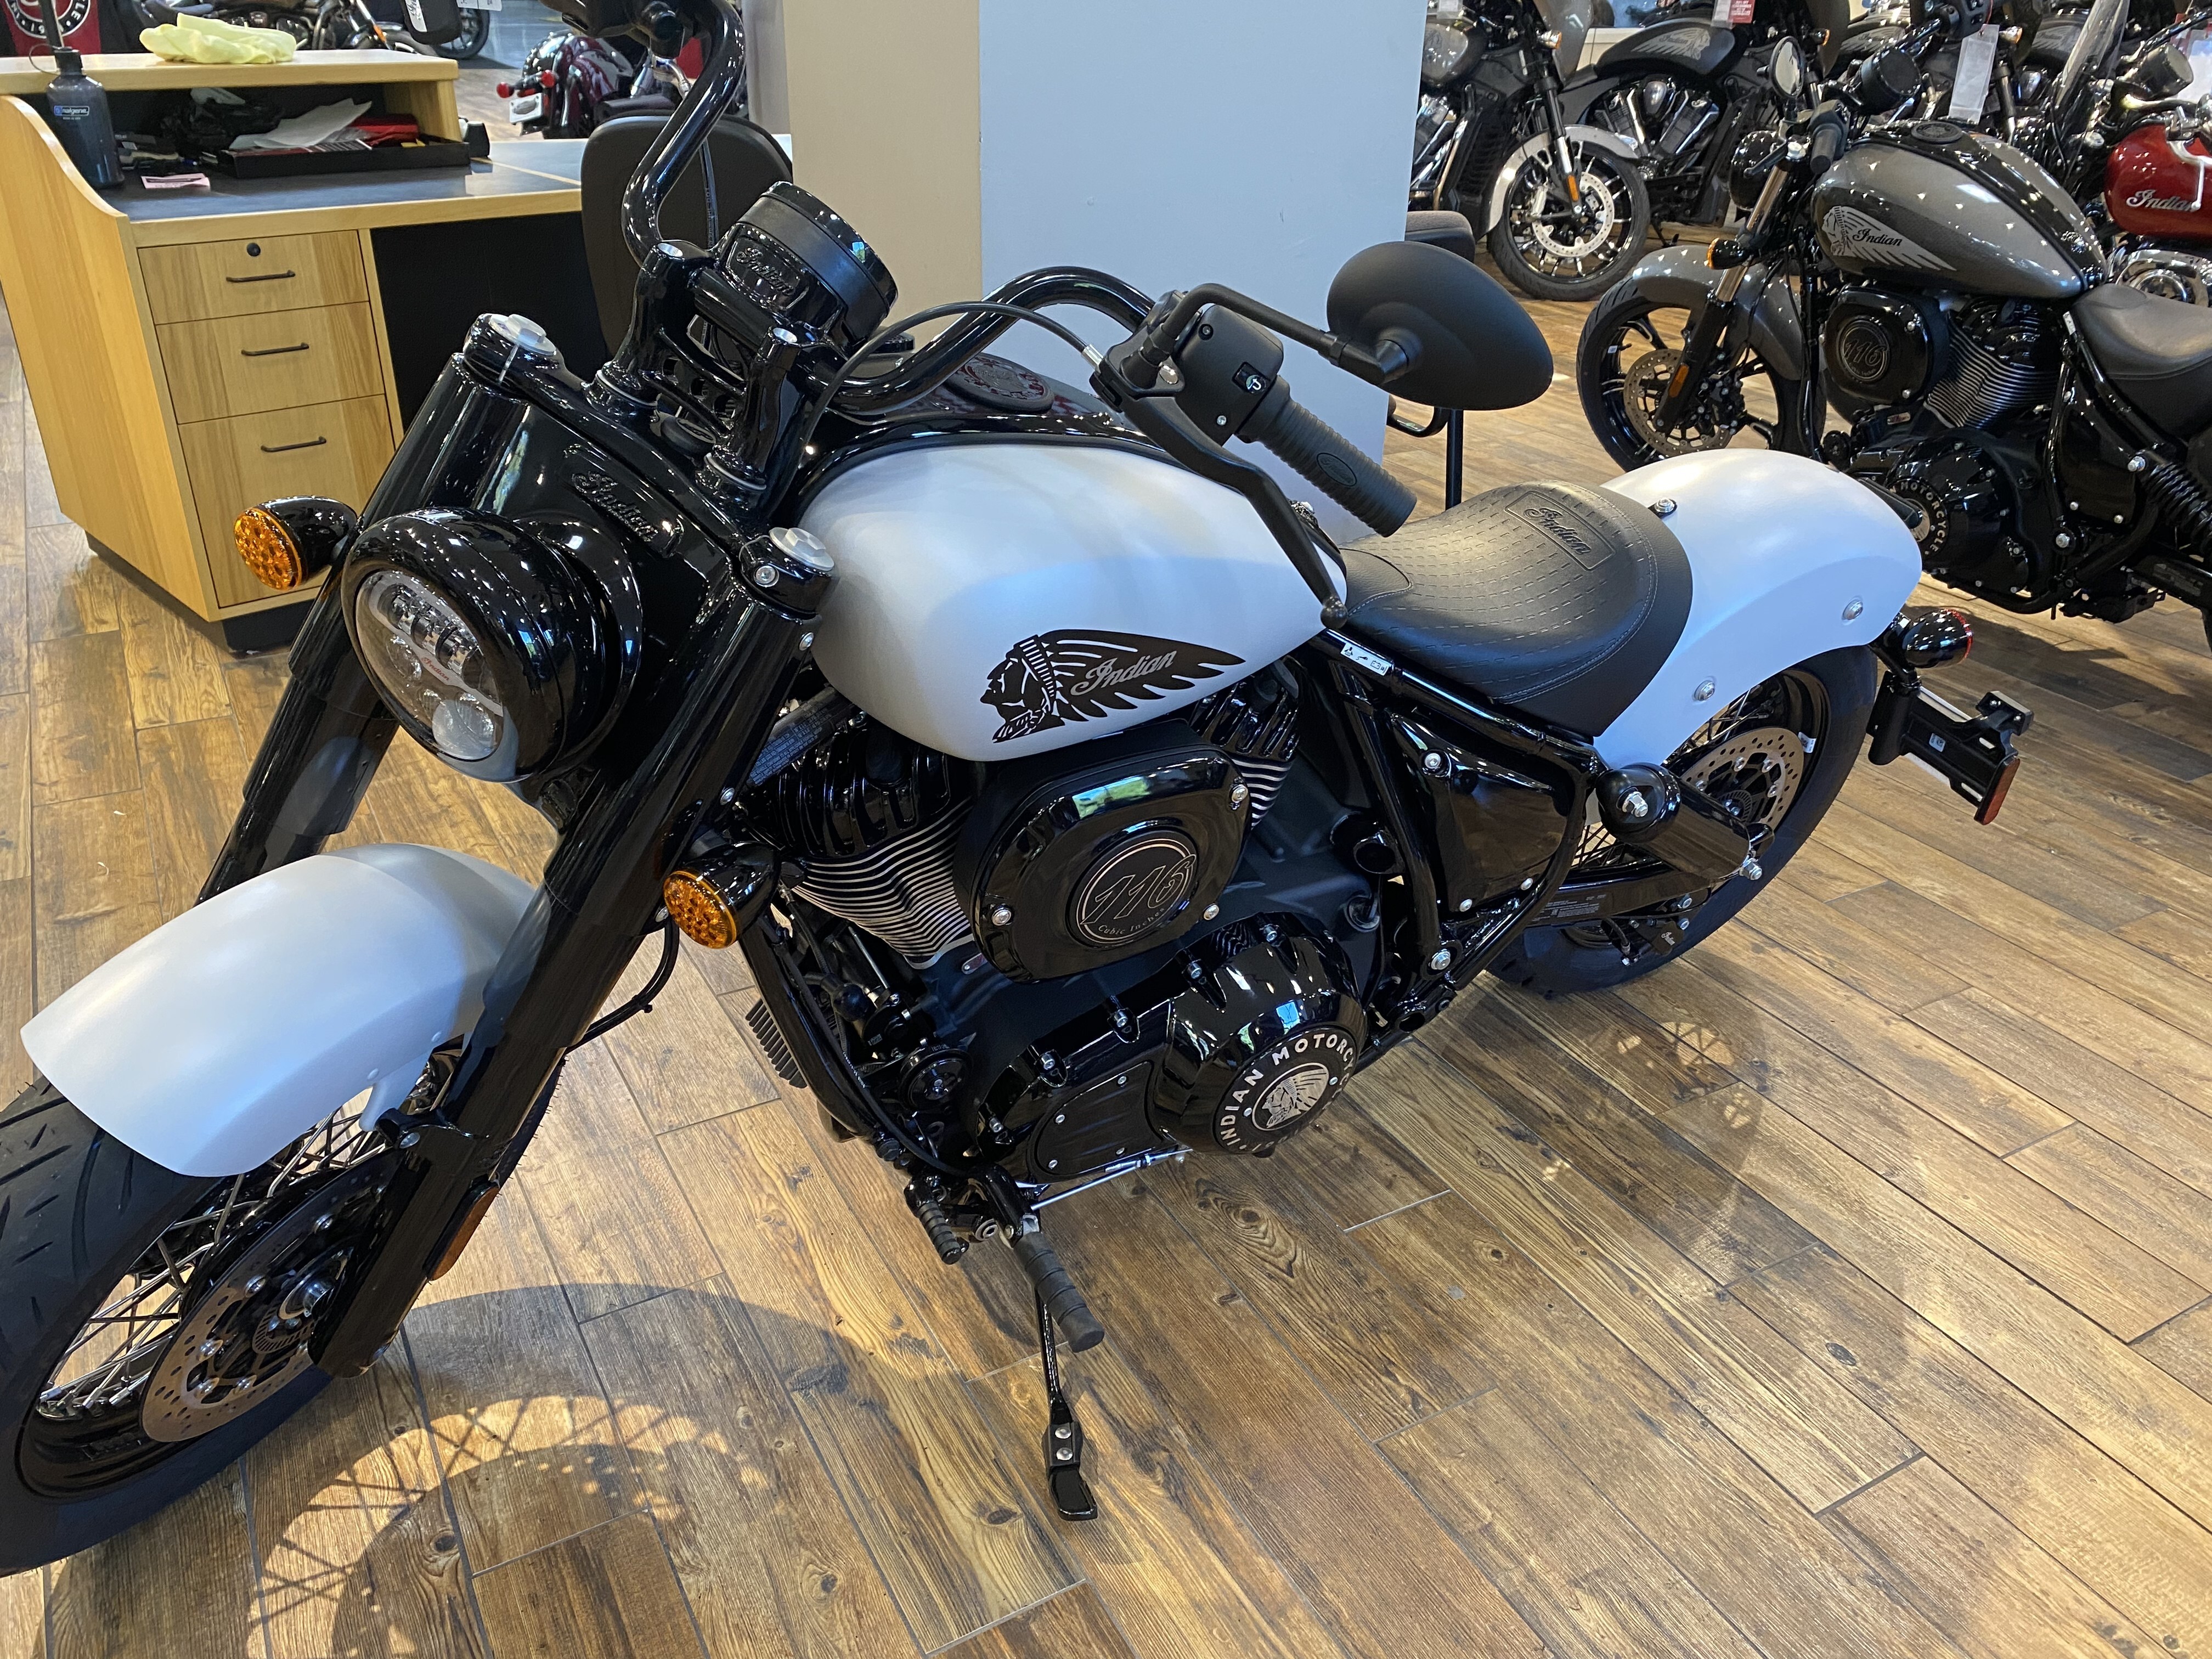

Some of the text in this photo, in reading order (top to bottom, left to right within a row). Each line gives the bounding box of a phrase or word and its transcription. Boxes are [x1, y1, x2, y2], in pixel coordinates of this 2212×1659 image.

[1852, 228, 1903, 246] Indian
[736, 247, 796, 296] Indian
[1844, 339, 1888, 366] 116
[572, 470, 659, 543] Indian
[1523, 501, 1592, 555] Indian
[1900, 482, 1946, 552] MOTORCYCLE
[421, 657, 450, 681] Indian
[1070, 650, 1177, 696] Indian
[1080, 854, 1197, 925] 116
[1098, 907, 1165, 935] Cubic Inches
[1220, 1069, 1264, 1146] INDIAN
